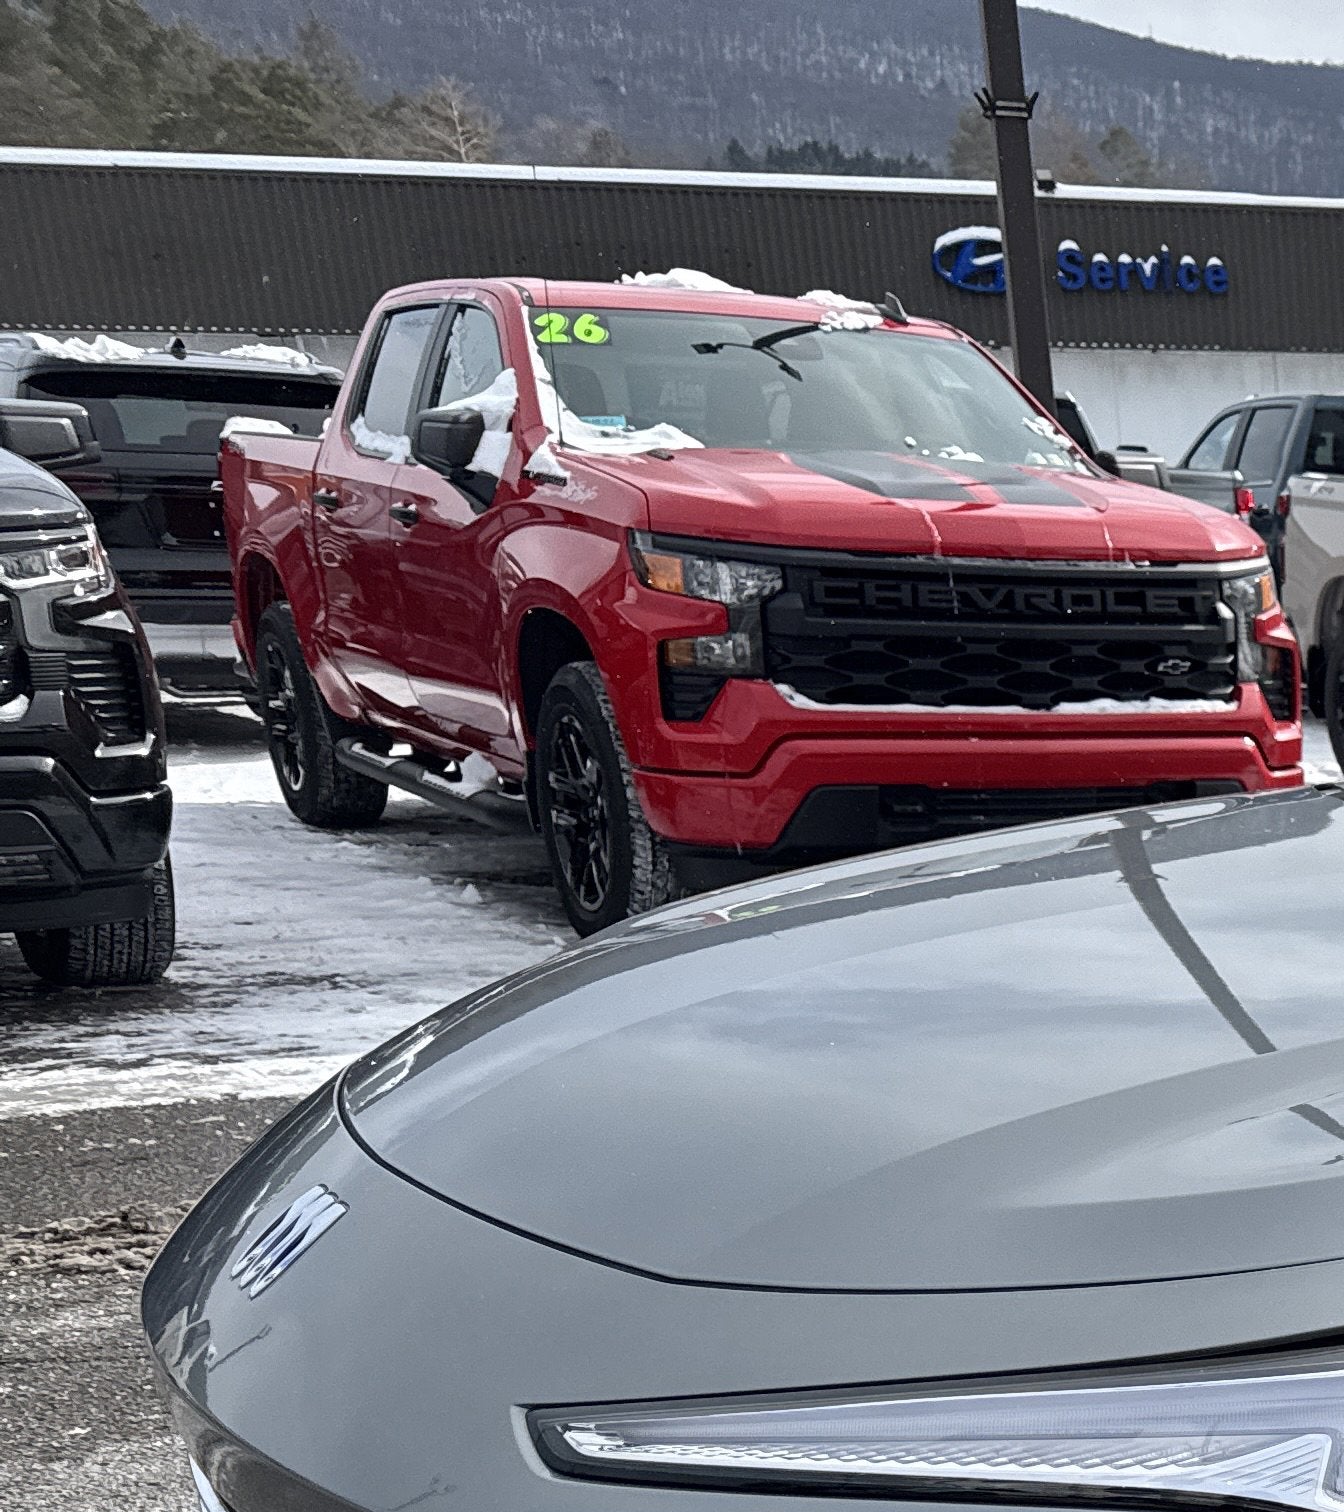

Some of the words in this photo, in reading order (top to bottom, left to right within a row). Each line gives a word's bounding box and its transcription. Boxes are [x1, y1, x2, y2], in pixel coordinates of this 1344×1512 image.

[1056, 241, 1230, 294] Service
[533, 311, 609, 345] 26
[812, 579, 1217, 618] CHEVROLET
